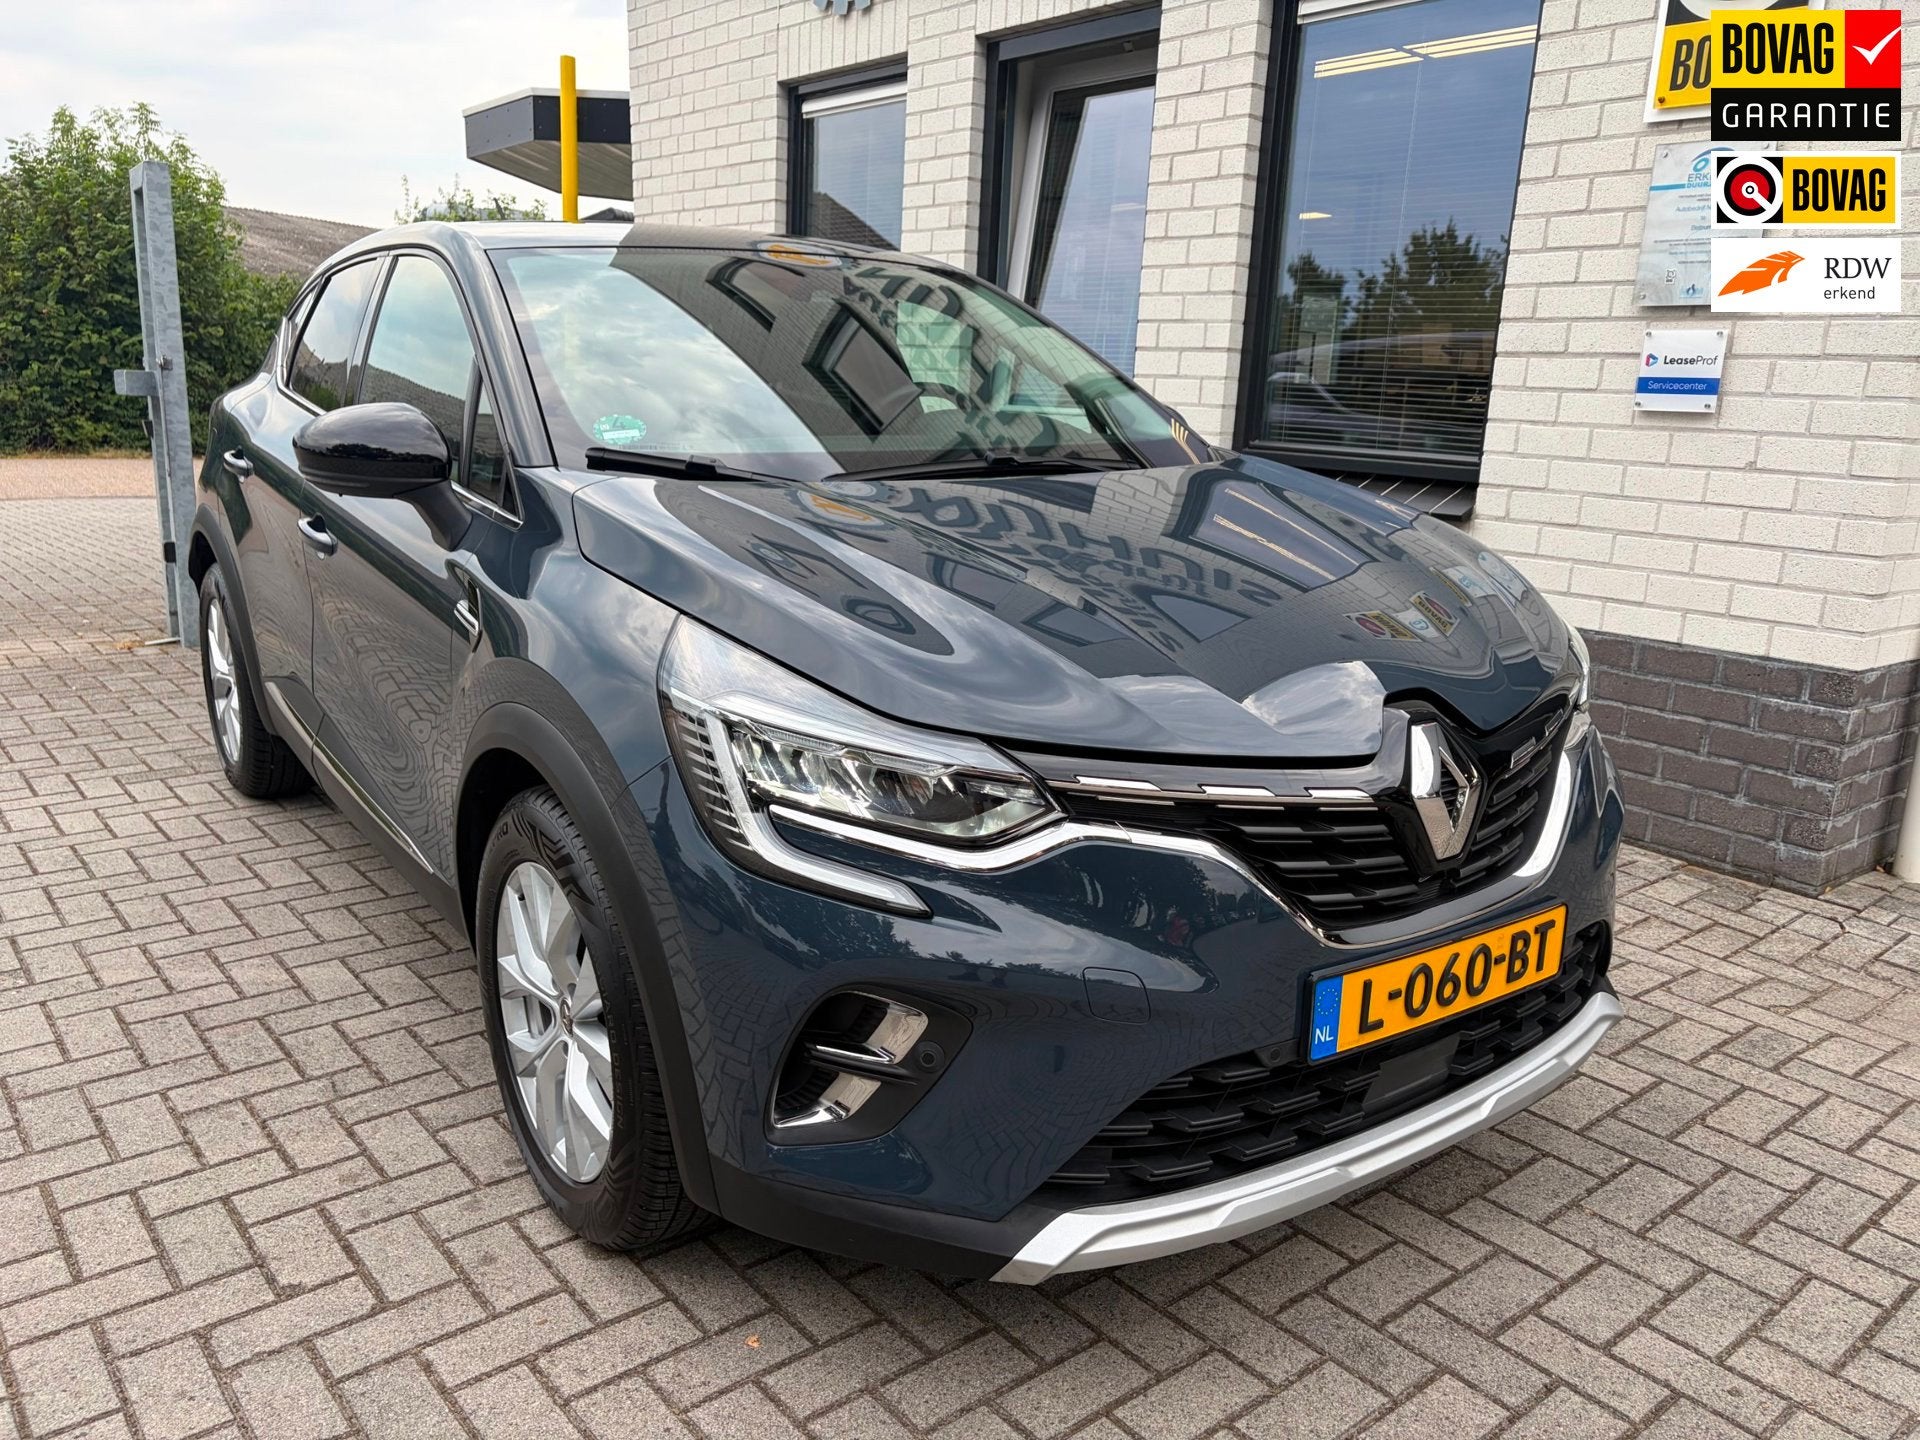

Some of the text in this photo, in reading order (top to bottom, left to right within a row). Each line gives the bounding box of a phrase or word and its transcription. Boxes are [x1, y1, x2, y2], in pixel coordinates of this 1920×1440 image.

[1668, 34, 1711, 92] BO
[1687, 172, 1711, 182] ERK
[1663, 354, 1718, 367] LeaseProf
[1647, 380, 1708, 391] Servicecenter
[1358, 919, 1556, 1034] L-060-BT
[1314, 1025, 1334, 1045] NL
